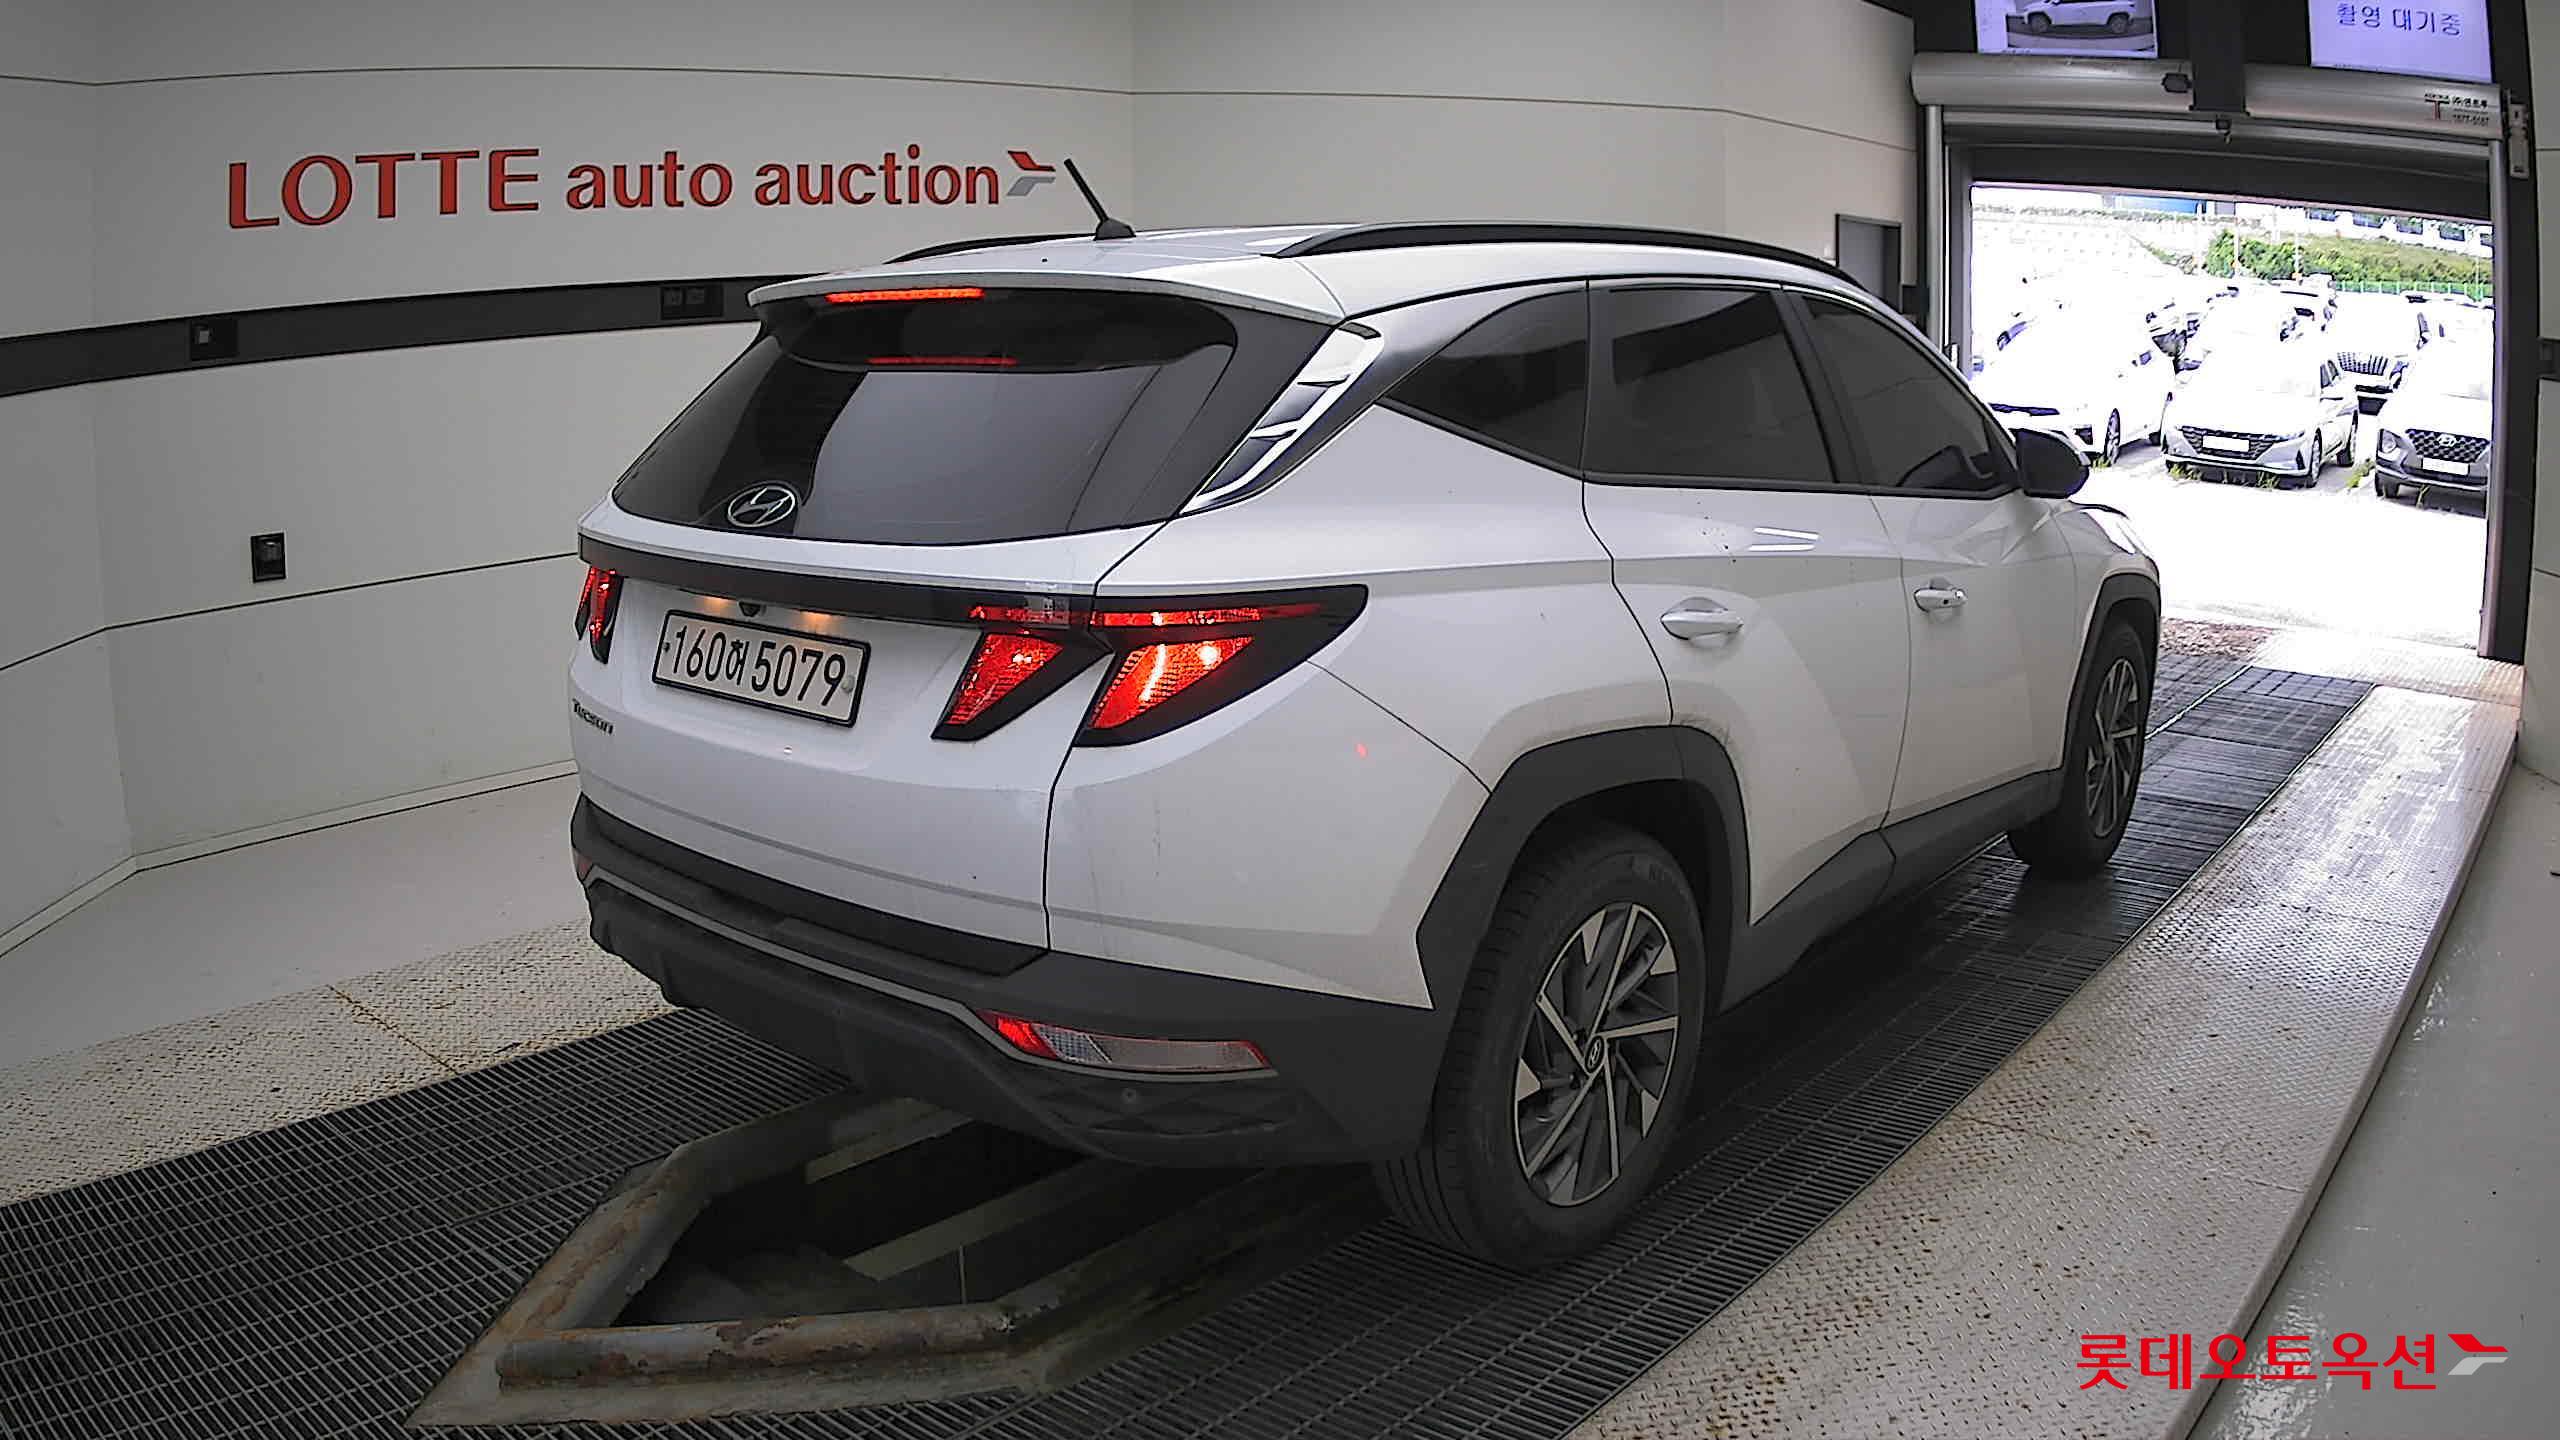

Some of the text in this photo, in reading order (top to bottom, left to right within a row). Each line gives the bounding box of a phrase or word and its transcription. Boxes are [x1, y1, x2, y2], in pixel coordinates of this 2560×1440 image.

[2336, 3, 2461, 36] 촬영 대기중
[229, 143, 1000, 229] LOTTE auto auction
[673, 625, 847, 706] 160허 5079
